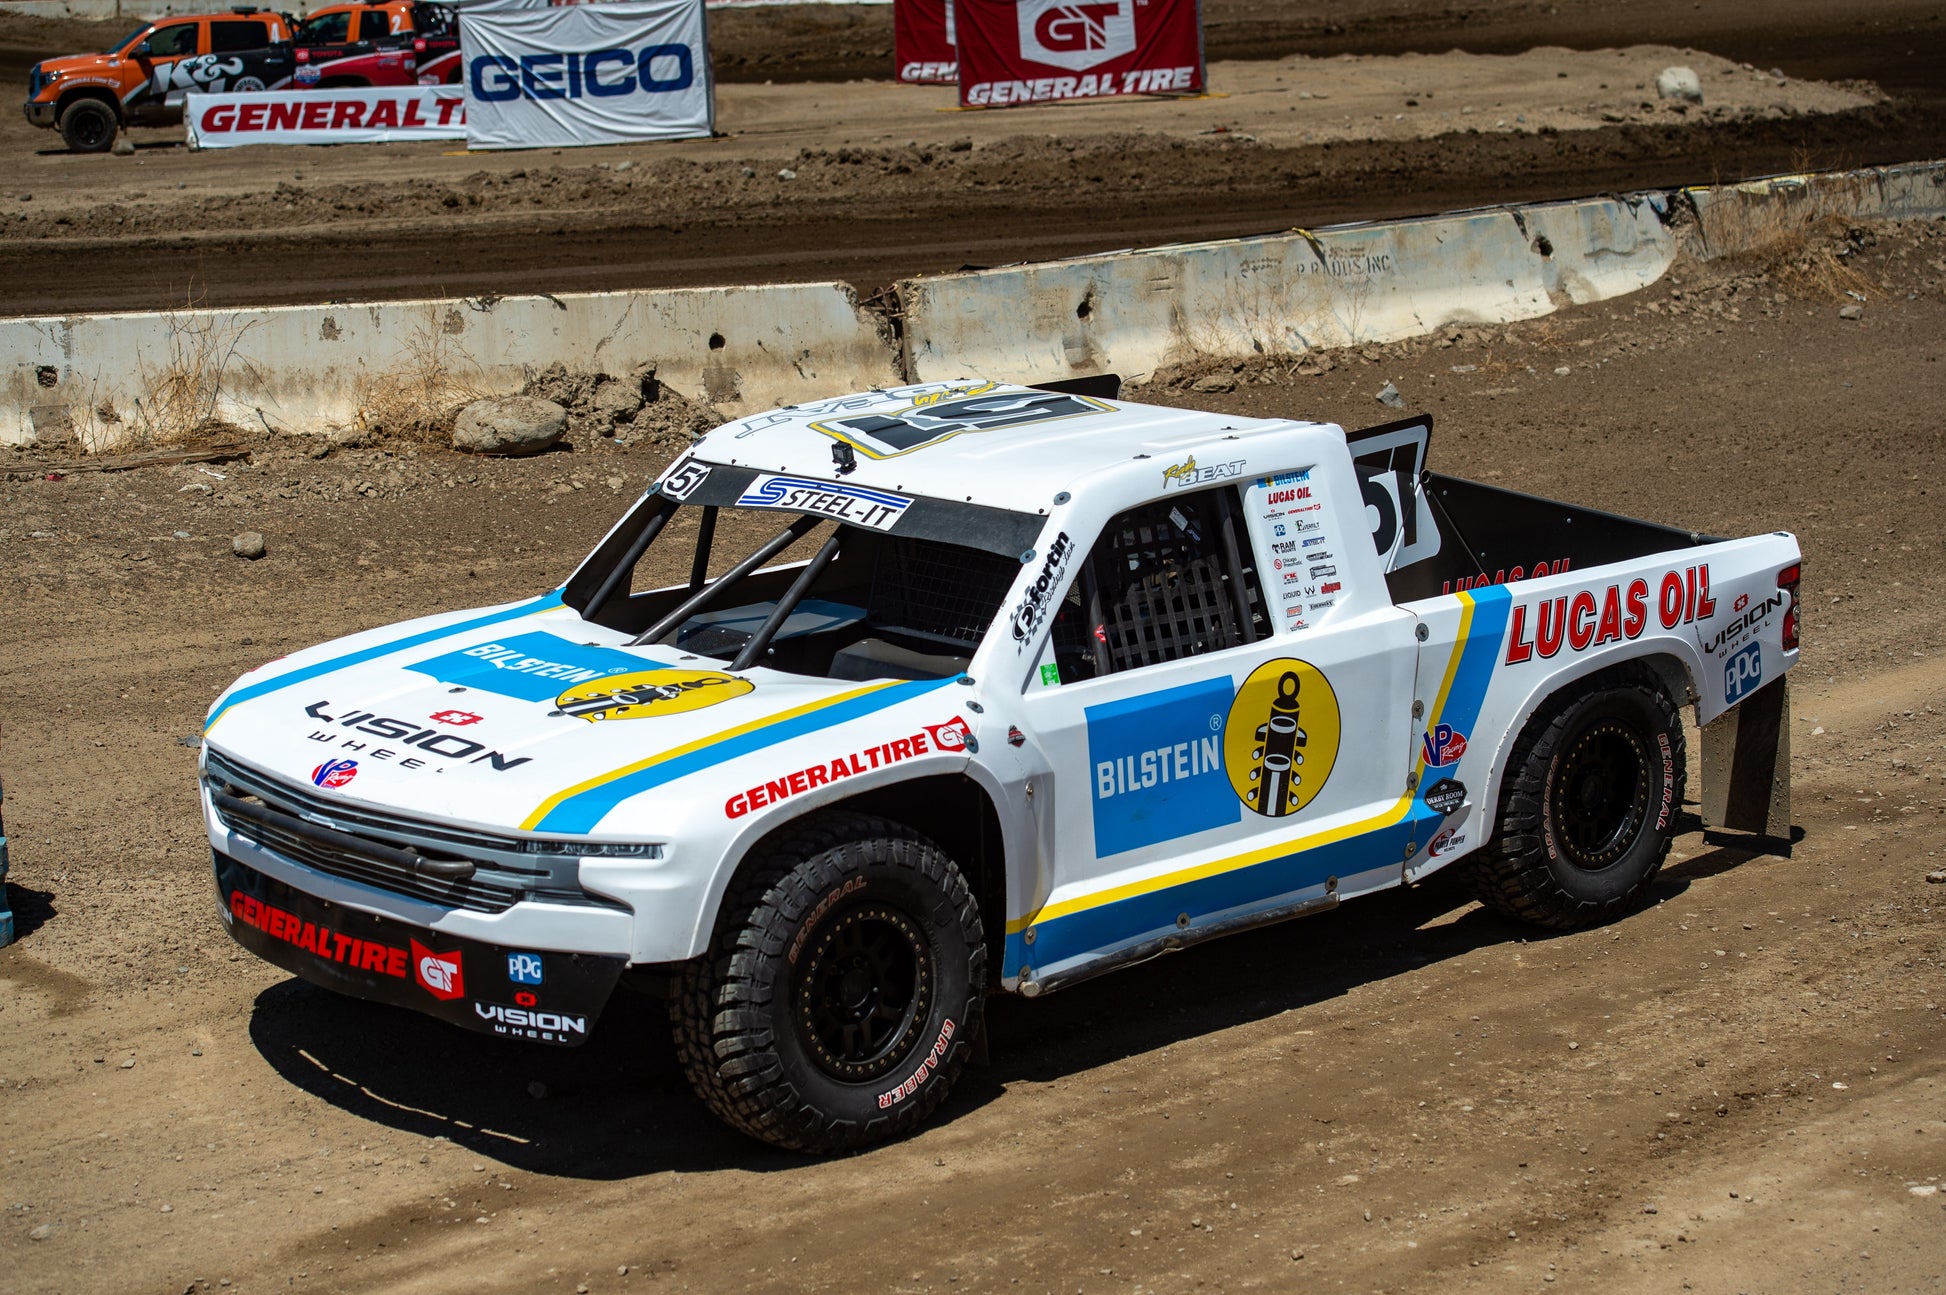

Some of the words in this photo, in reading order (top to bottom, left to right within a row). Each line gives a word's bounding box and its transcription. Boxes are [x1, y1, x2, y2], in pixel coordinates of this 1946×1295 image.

[470, 44, 694, 102] GEICO
[901, 61, 958, 81] GEN
[967, 73, 1116, 105] GENERAL
[1122, 66, 1195, 94] TIRE
[200, 98, 429, 133] GENERAL
[666, 467, 707, 497] 51
[1179, 460, 1246, 486] BEAT
[1273, 471, 1310, 486] BILSTEIN
[782, 490, 899, 526] STEEL-IT
[1268, 489, 1295, 505] LUCAS
[1296, 487, 1311, 500] OIL
[1280, 540, 1296, 549] RAM
[1029, 531, 1069, 603] fortin
[1283, 590, 1301, 600] LIQUID
[1505, 578, 1649, 665] LUCAS
[1657, 563, 1717, 630] OIL
[1705, 591, 1782, 653] VISION
[1719, 620, 1770, 658] WHEEL
[462, 643, 606, 683] BILSTEIN
[1726, 651, 1760, 695] PPG
[304, 700, 534, 771] VISION
[725, 753, 867, 819] GENERAL
[863, 733, 929, 769] TIRE
[1097, 735, 1220, 799] BILSTEIN
[1656, 733, 1674, 830] GENERAL
[1427, 793, 1445, 805] DERBY
[1445, 790, 1463, 801] ROOM
[230, 890, 331, 959] GENERAL
[333, 932, 409, 979] TIRE
[788, 875, 867, 964] GENERAL
[509, 954, 542, 980] PPG
[475, 1002, 585, 1033] VISION
[494, 1024, 568, 1042] WHEEL
[878, 1018, 956, 1108] GRABBER
